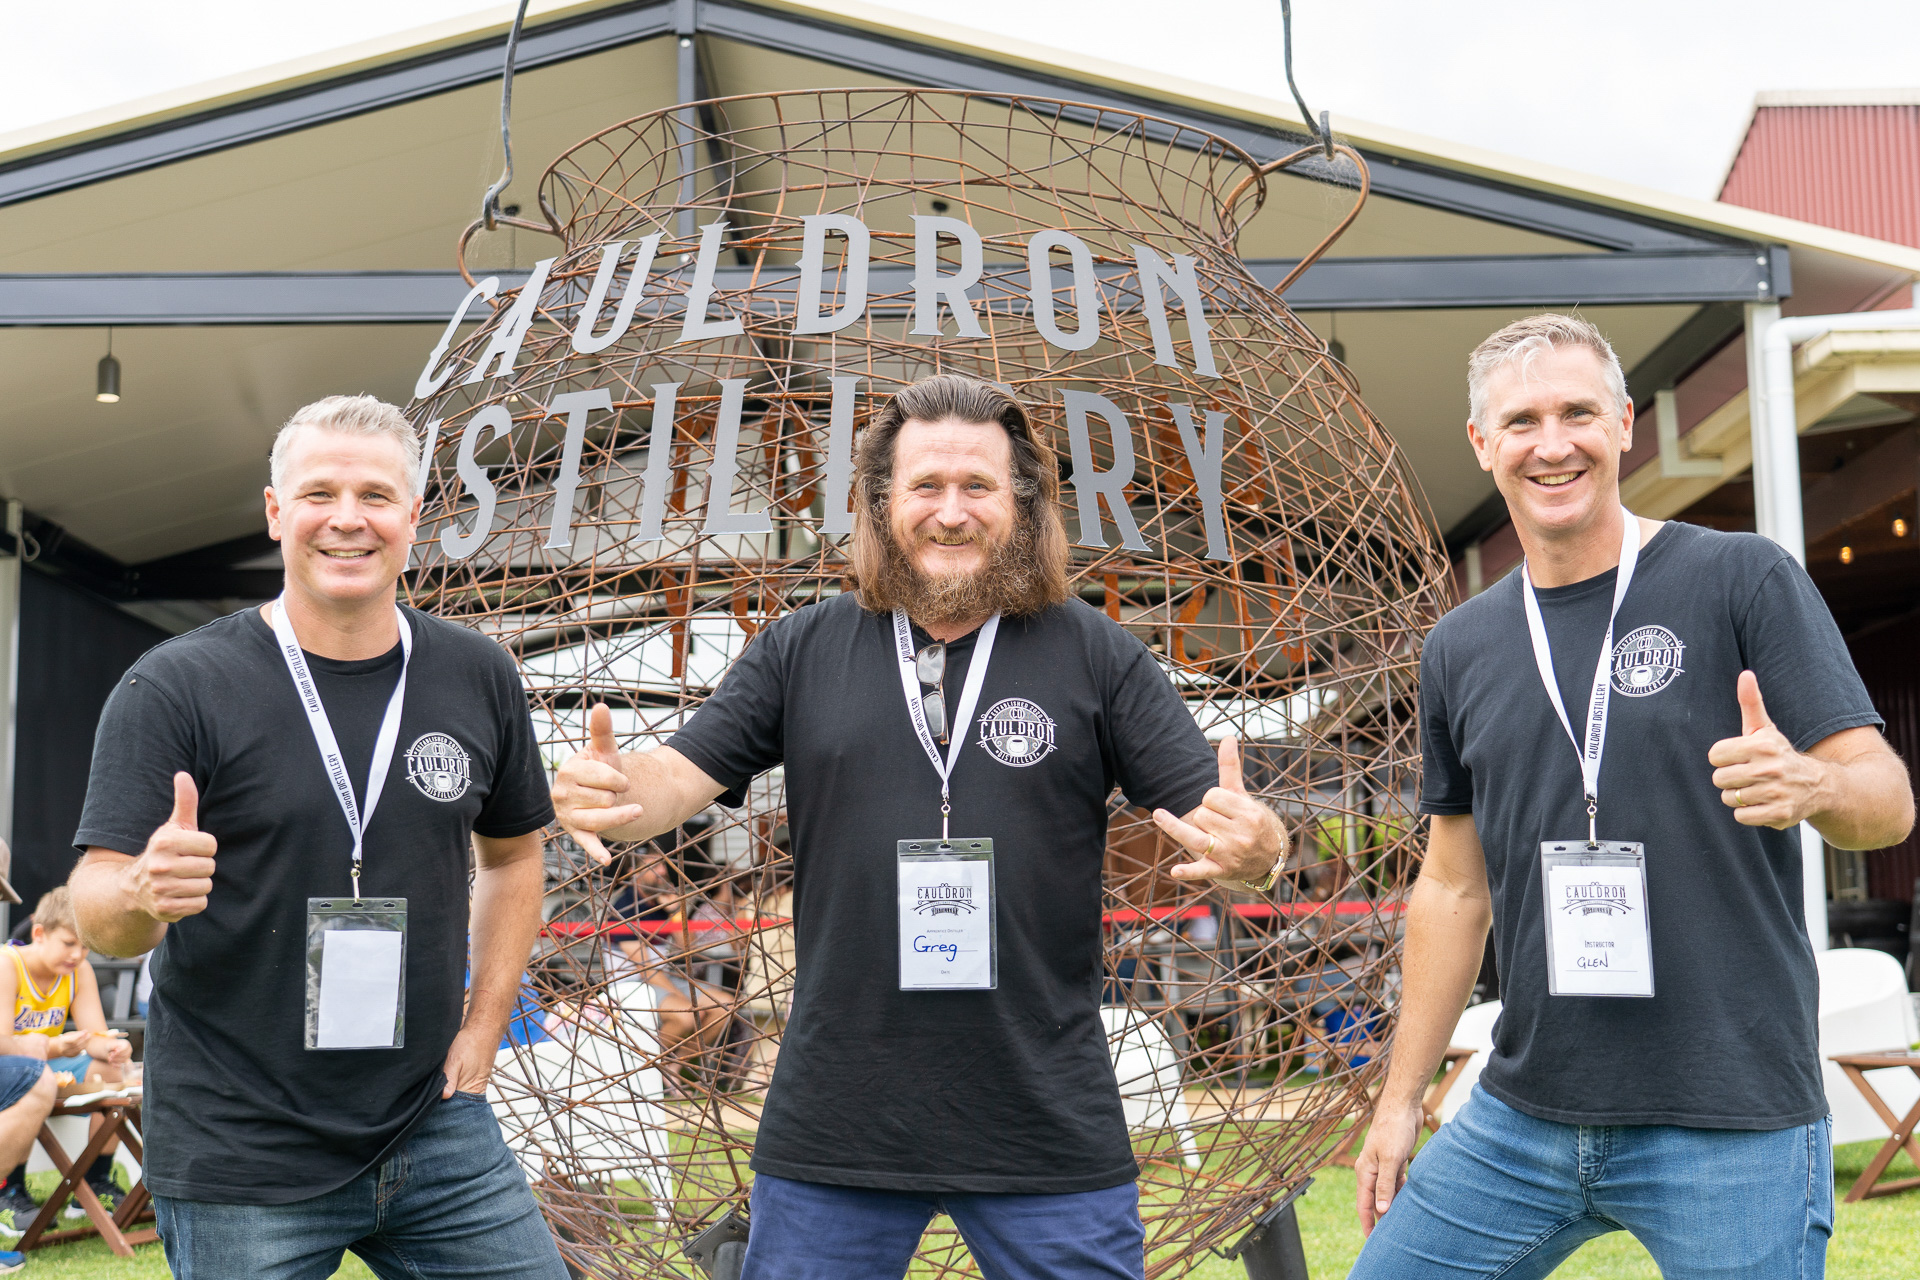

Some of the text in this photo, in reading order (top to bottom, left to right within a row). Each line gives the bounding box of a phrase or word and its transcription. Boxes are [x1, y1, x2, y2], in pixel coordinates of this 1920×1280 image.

[414, 213, 1221, 399] CAULDRON
[402, 376, 1233, 570] ISTILLRY
[1611, 648, 1683, 672] AULDRON
[286, 644, 320, 713] CAULDRON DISTILLERY
[1620, 681, 1663, 694] DISTILLERY
[911, 697, 938, 763] CAULDRON DISTILLERY
[980, 721, 1055, 744] CAULDRON
[1589, 683, 1606, 760] CAULDRON DISTILLERY
[407, 757, 470, 778] CAULDRON
[327, 753, 358, 826] CAULDRON DISTILLERY
[917, 887, 972, 899] CAULDRON
[1565, 886, 1626, 898] CAULDRON
[913, 935, 957, 962] Greg
[1577, 950, 1609, 969] GLEN
